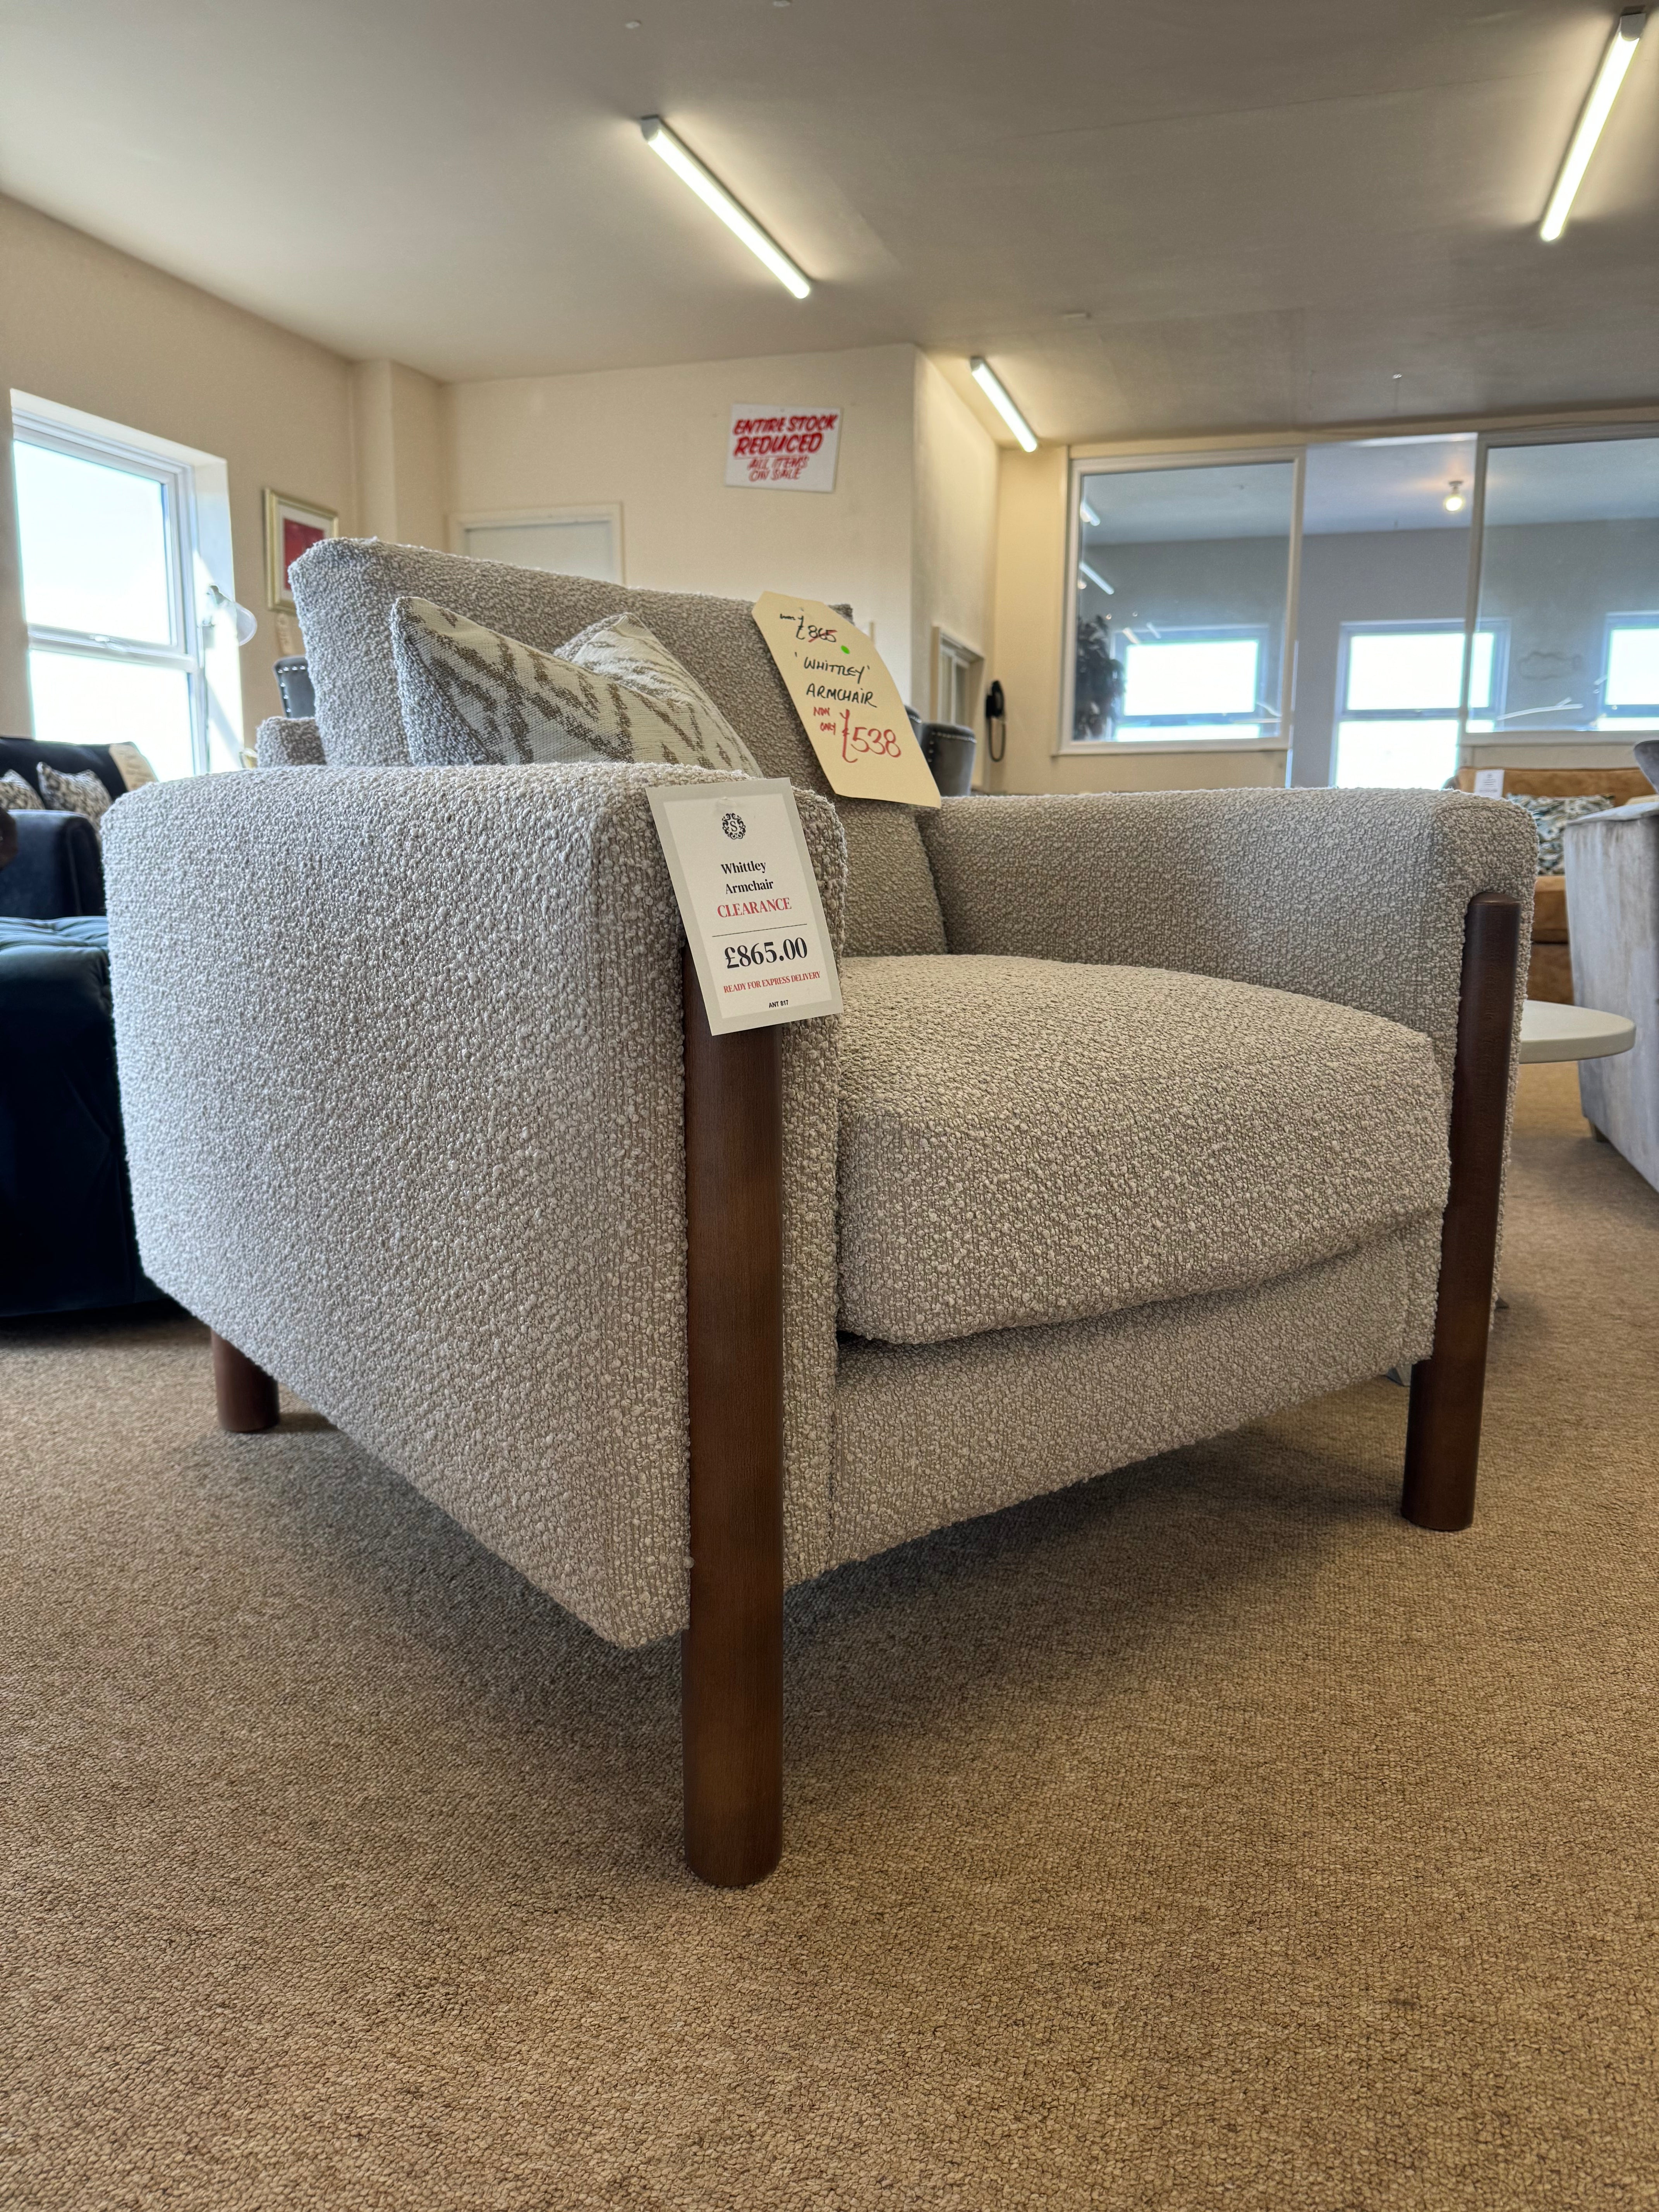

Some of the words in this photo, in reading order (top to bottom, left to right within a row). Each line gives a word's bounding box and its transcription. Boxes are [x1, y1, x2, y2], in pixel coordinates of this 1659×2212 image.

[733, 417, 785, 434] ENTIRE
[787, 414, 838, 432] STOCK
[734, 432, 823, 456] REDUCED
[747, 458, 769, 470] ALL
[749, 470, 769, 482] ON
[771, 469, 801, 481] SALE
[796, 615, 837, 643] £865
[806, 683, 877, 708] ARMCHAIR
[840, 709, 901, 763] £538
[721, 860, 766, 874] Whittley
[725, 879, 774, 895] Armchair
[717, 898, 792, 918] CLEARANCE
[725, 937, 807, 969] £865.00
[723, 982, 746, 993] READY
[747, 981, 761, 989] FOR
[762, 975, 790, 987] EXPRESS
[791, 971, 820, 982] DELIVERY
